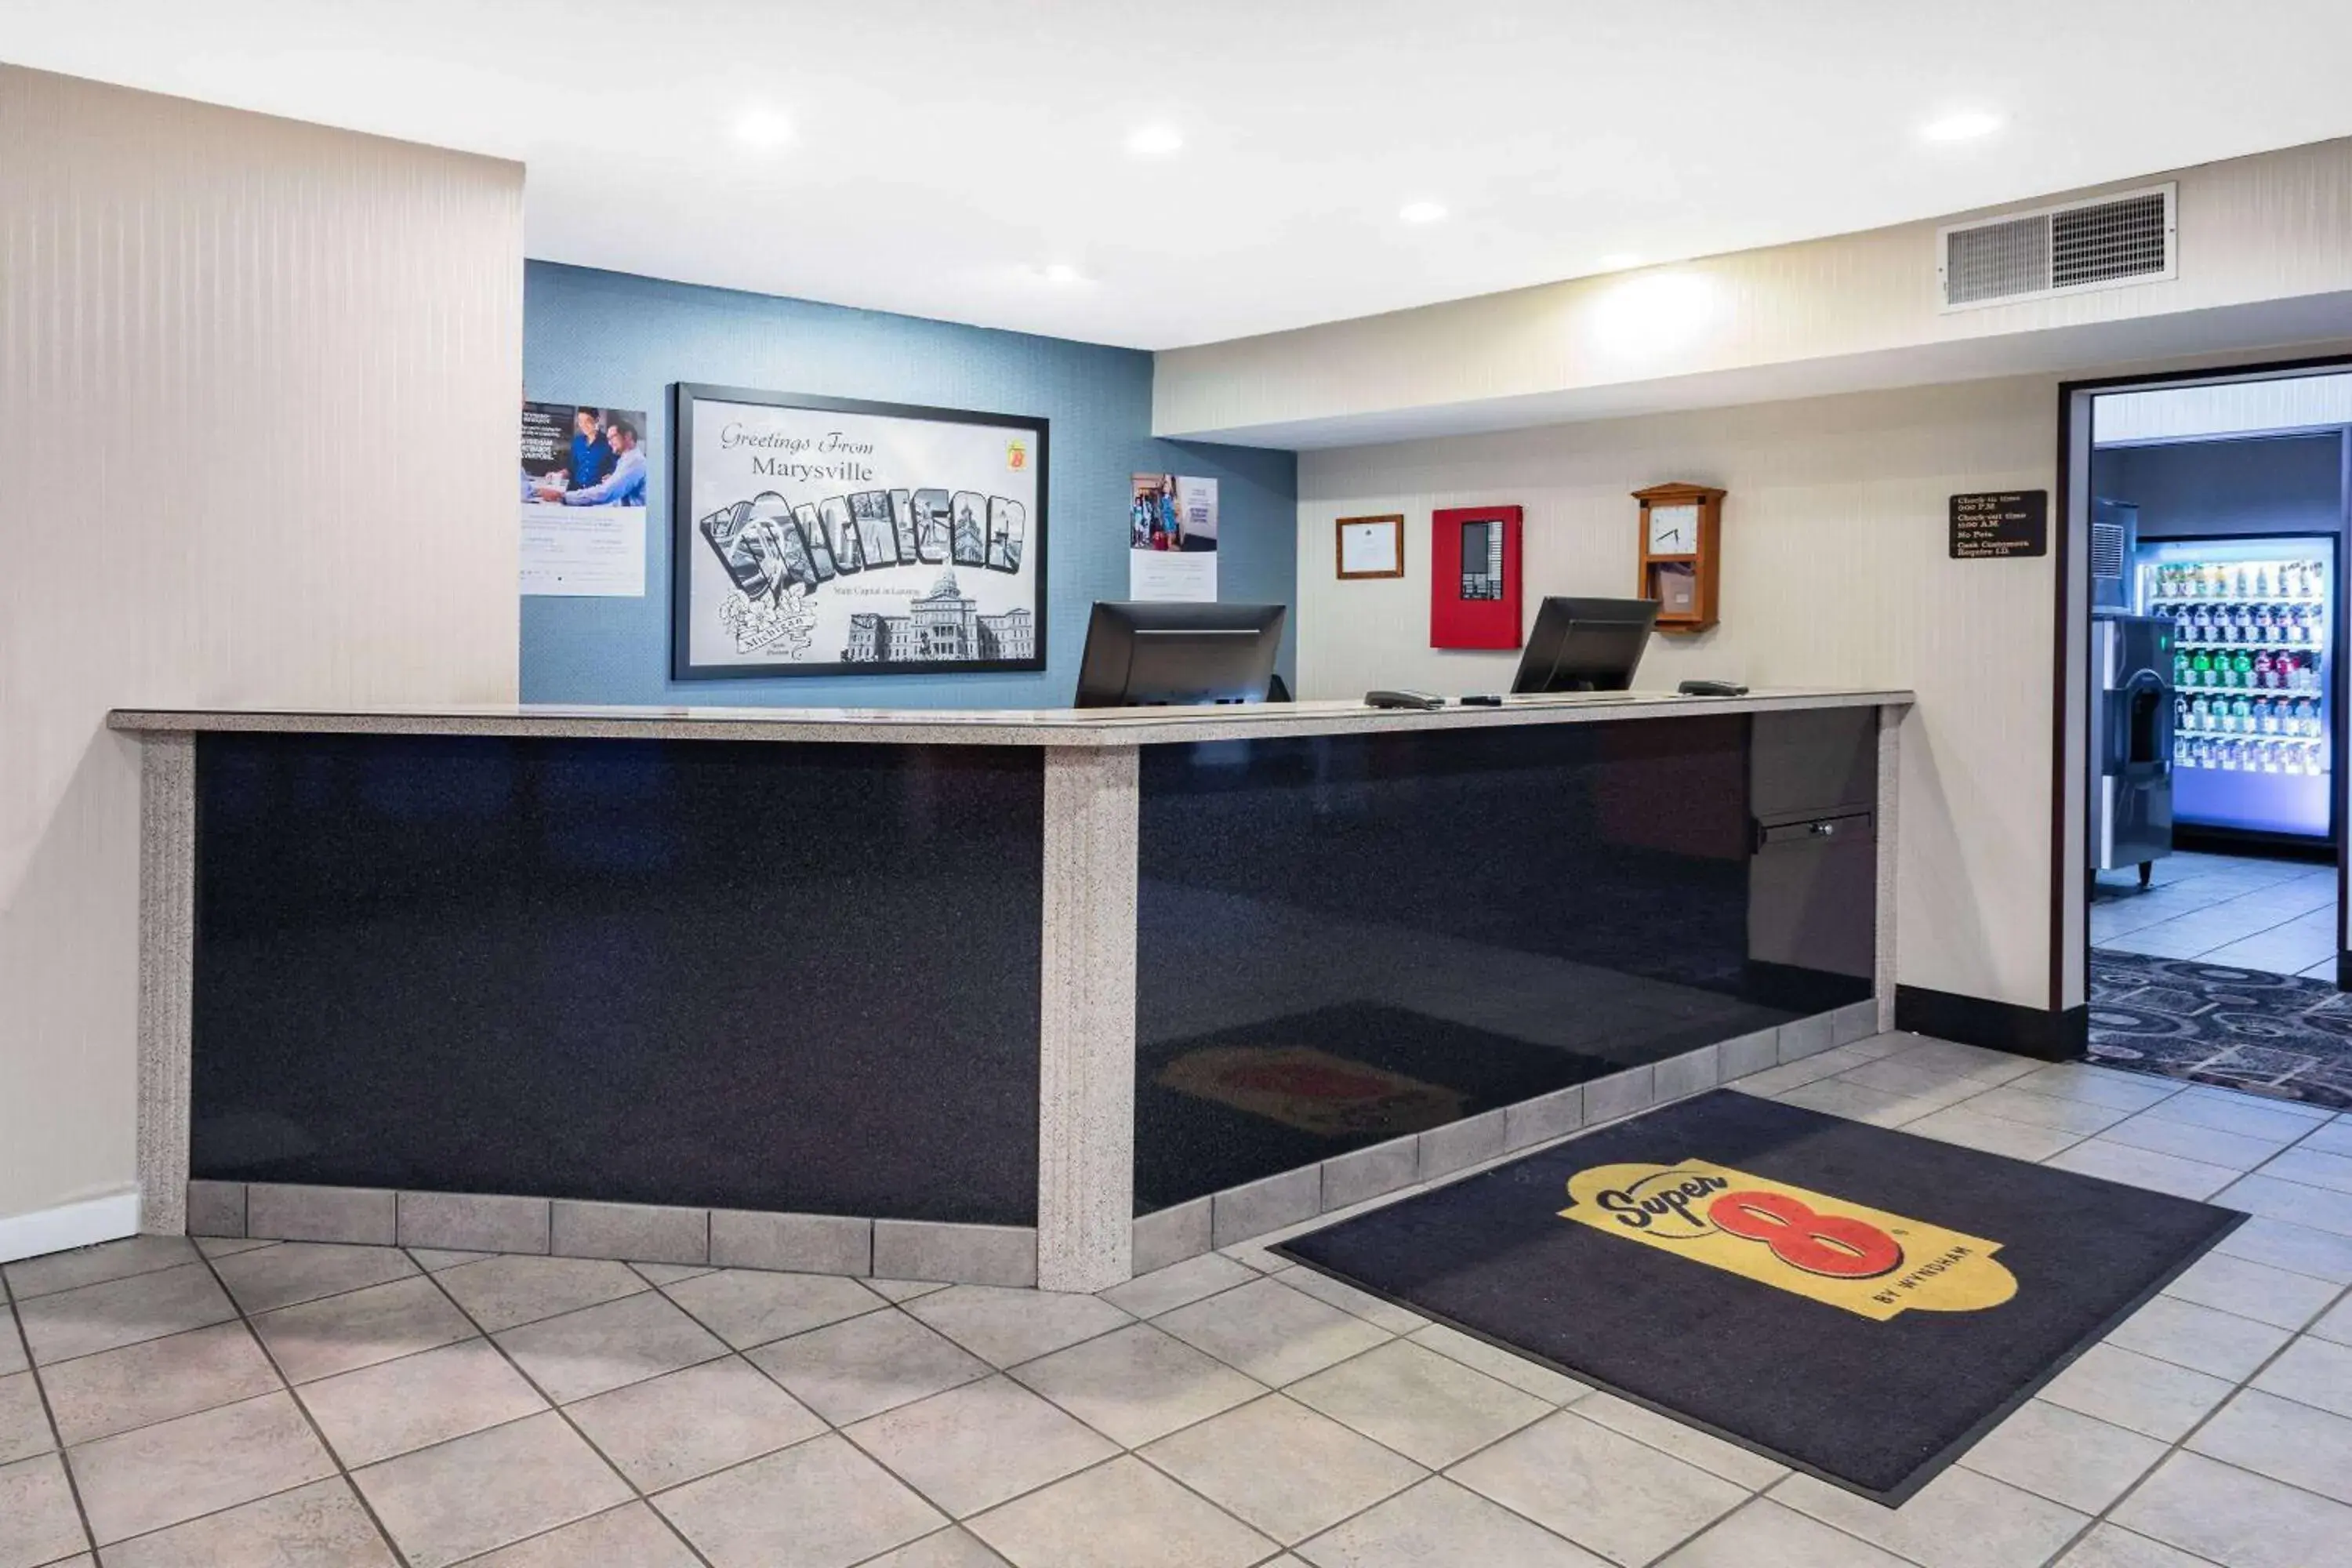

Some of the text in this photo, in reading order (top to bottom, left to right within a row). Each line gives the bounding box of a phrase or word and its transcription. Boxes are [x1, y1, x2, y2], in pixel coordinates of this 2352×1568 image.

[720, 422, 873, 455] Greetings From
[752, 456, 873, 482] Marysville
[744, 617, 804, 650] Michigan
[1595, 1175, 1728, 1229] Super
[1708, 1190, 1906, 1279] 8
[1872, 1244, 1973, 1305] BY WYNDHAM
